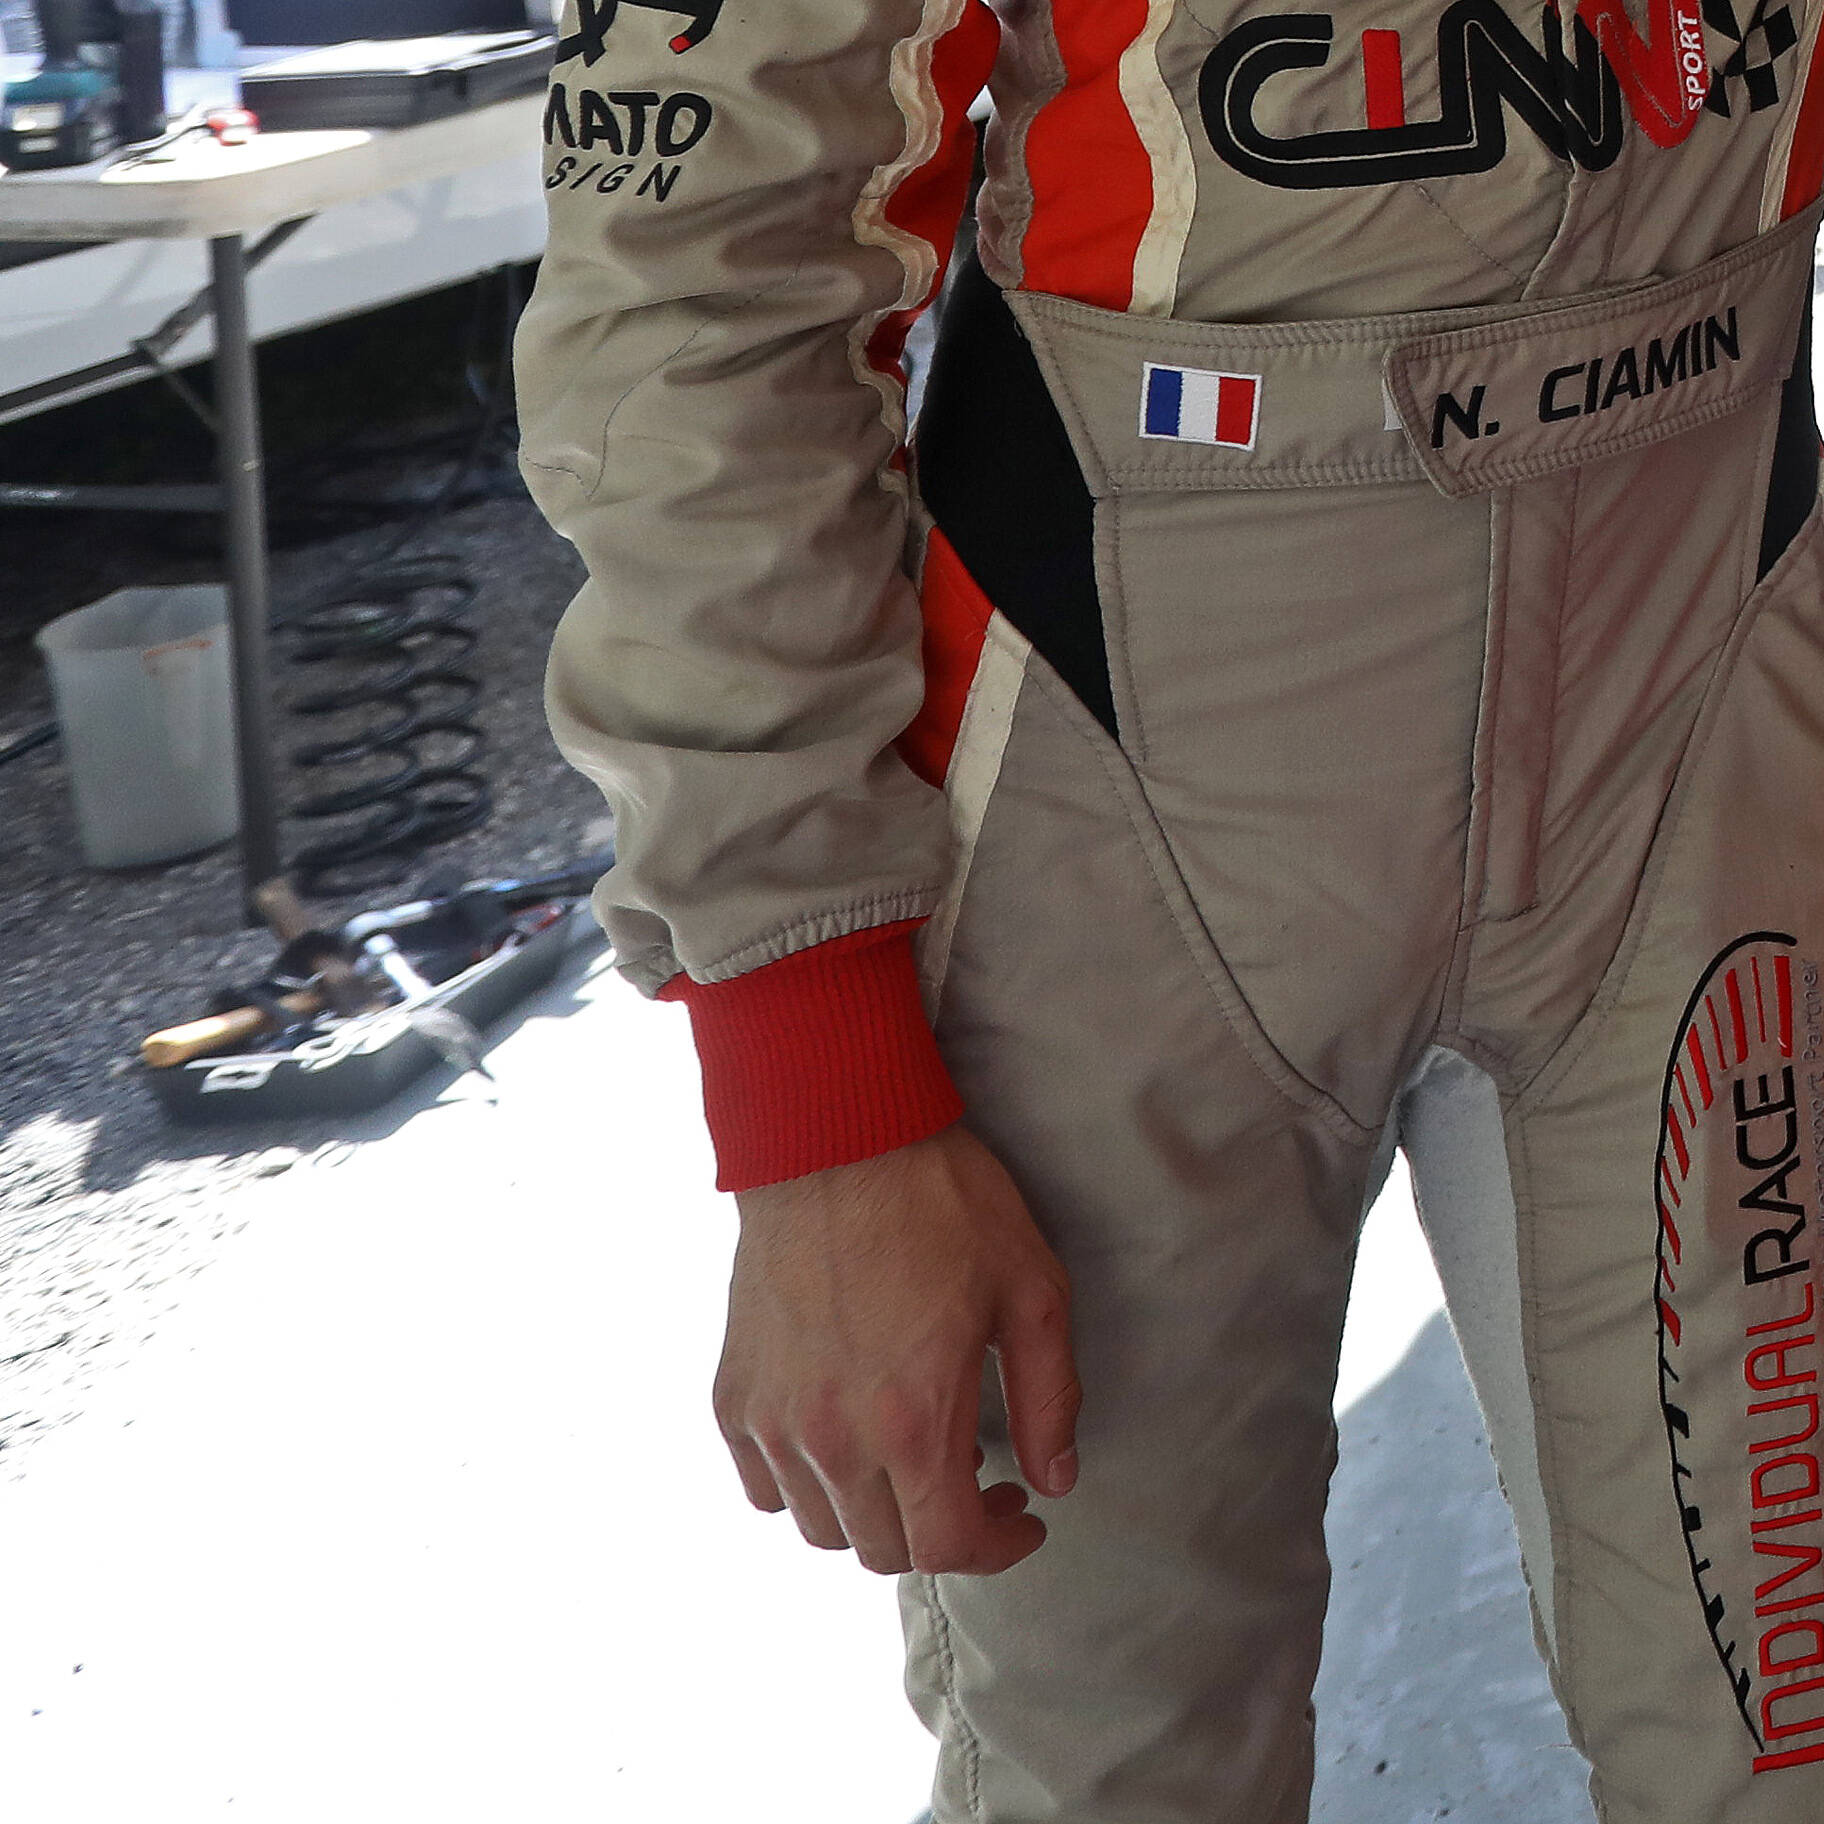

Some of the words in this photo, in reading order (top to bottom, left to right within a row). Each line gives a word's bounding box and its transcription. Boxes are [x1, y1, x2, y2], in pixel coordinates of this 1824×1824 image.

[1676, 9, 1706, 111] SPORT
[1431, 383, 1500, 449] N.
[1537, 305, 1742, 424] CIAMIN
